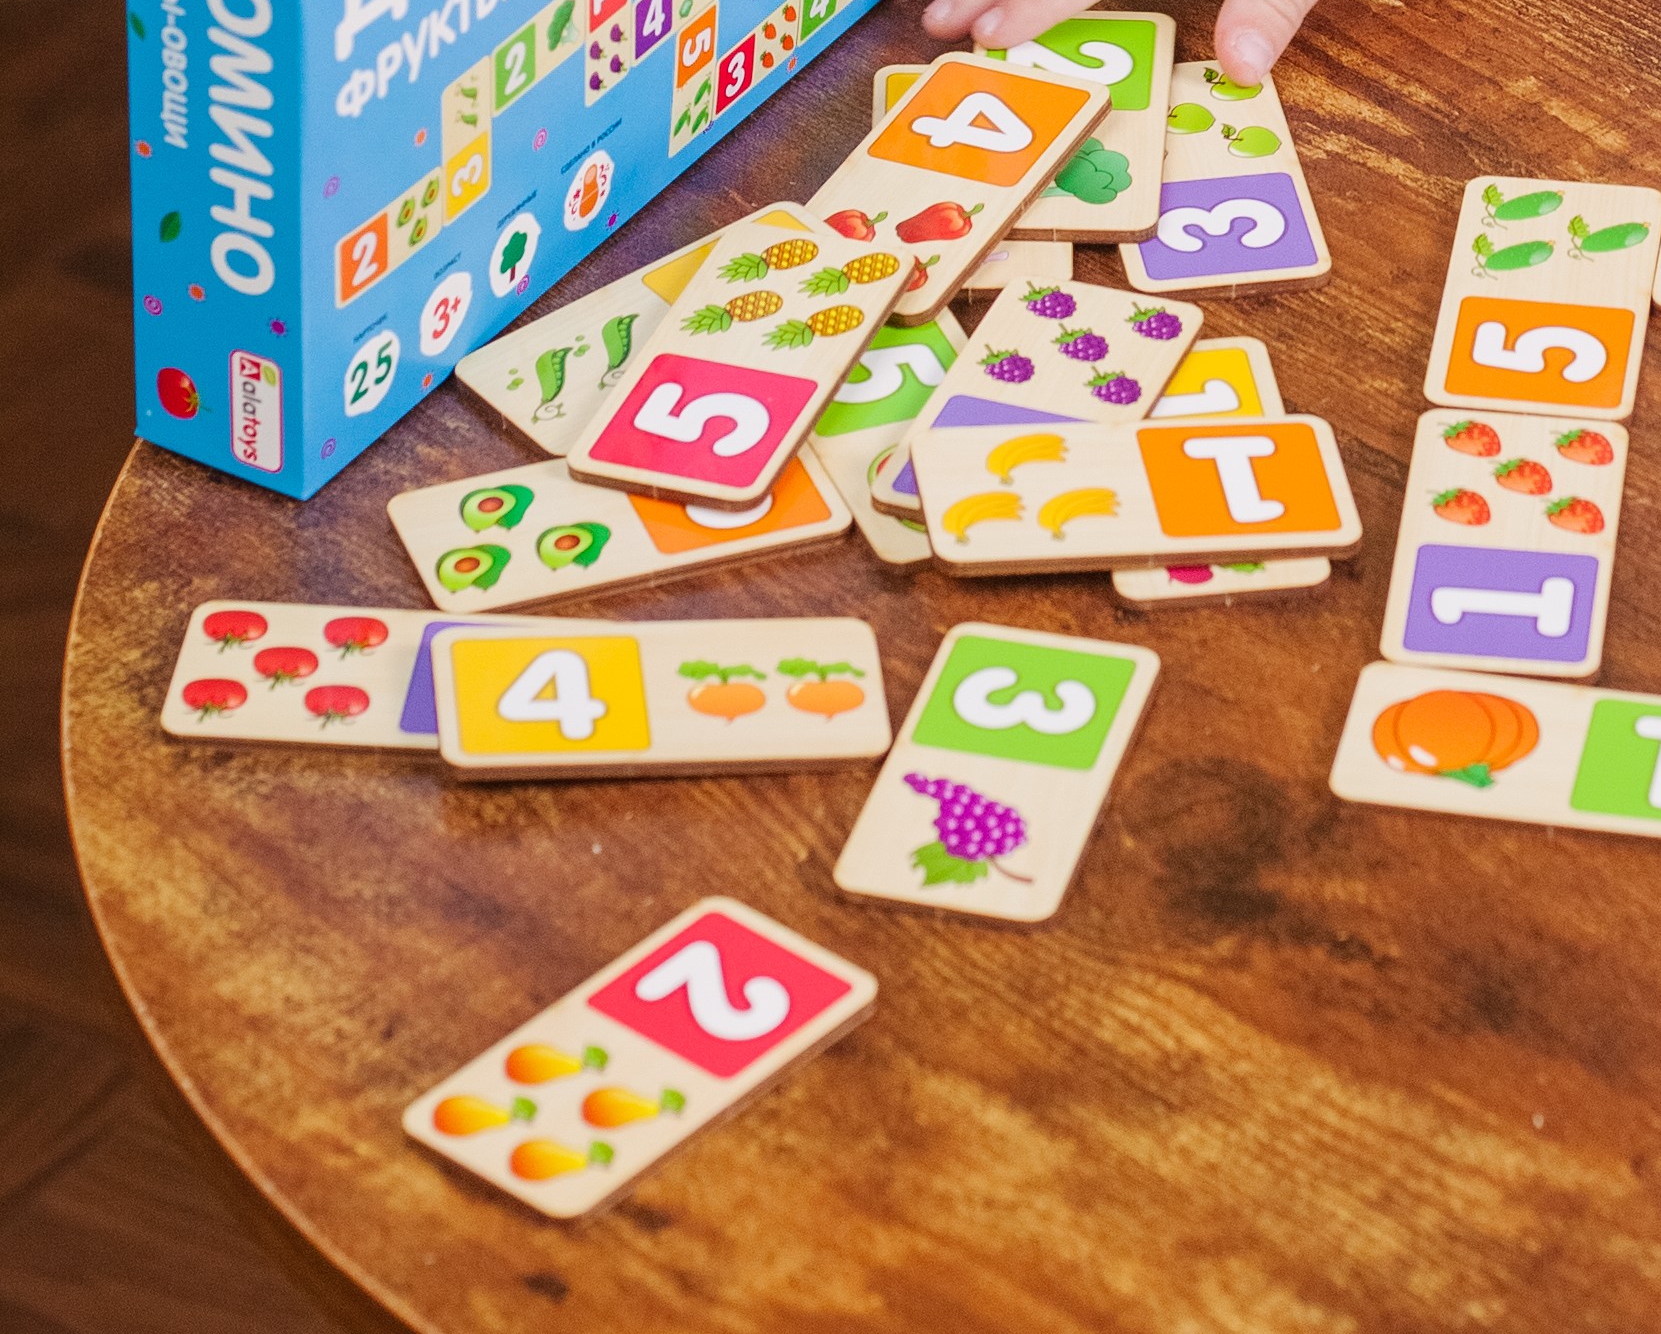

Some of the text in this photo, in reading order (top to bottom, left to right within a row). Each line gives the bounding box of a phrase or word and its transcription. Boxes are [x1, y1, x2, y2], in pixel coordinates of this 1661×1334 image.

[504, 40, 528, 95] 2
[682, 27, 712, 67] 5
[725, 51, 745, 98] 3
[984, 39, 1133, 91] 2
[910, 90, 1034, 152] 4
[452, 153, 483, 196] 3
[1156, 197, 1286, 253] 3
[352, 231, 379, 287] 2
[432, 296, 462, 340] 3+
[349, 340, 393, 405] 25
[1472, 321, 1607, 383] 5
[633, 382, 770, 457] 5
[1183, 436, 1285, 523] 1
[1430, 576, 1575, 638] 1
[498, 649, 606, 739] 4
[953, 666, 1096, 735] 3
[634, 940, 790, 1040] 2
